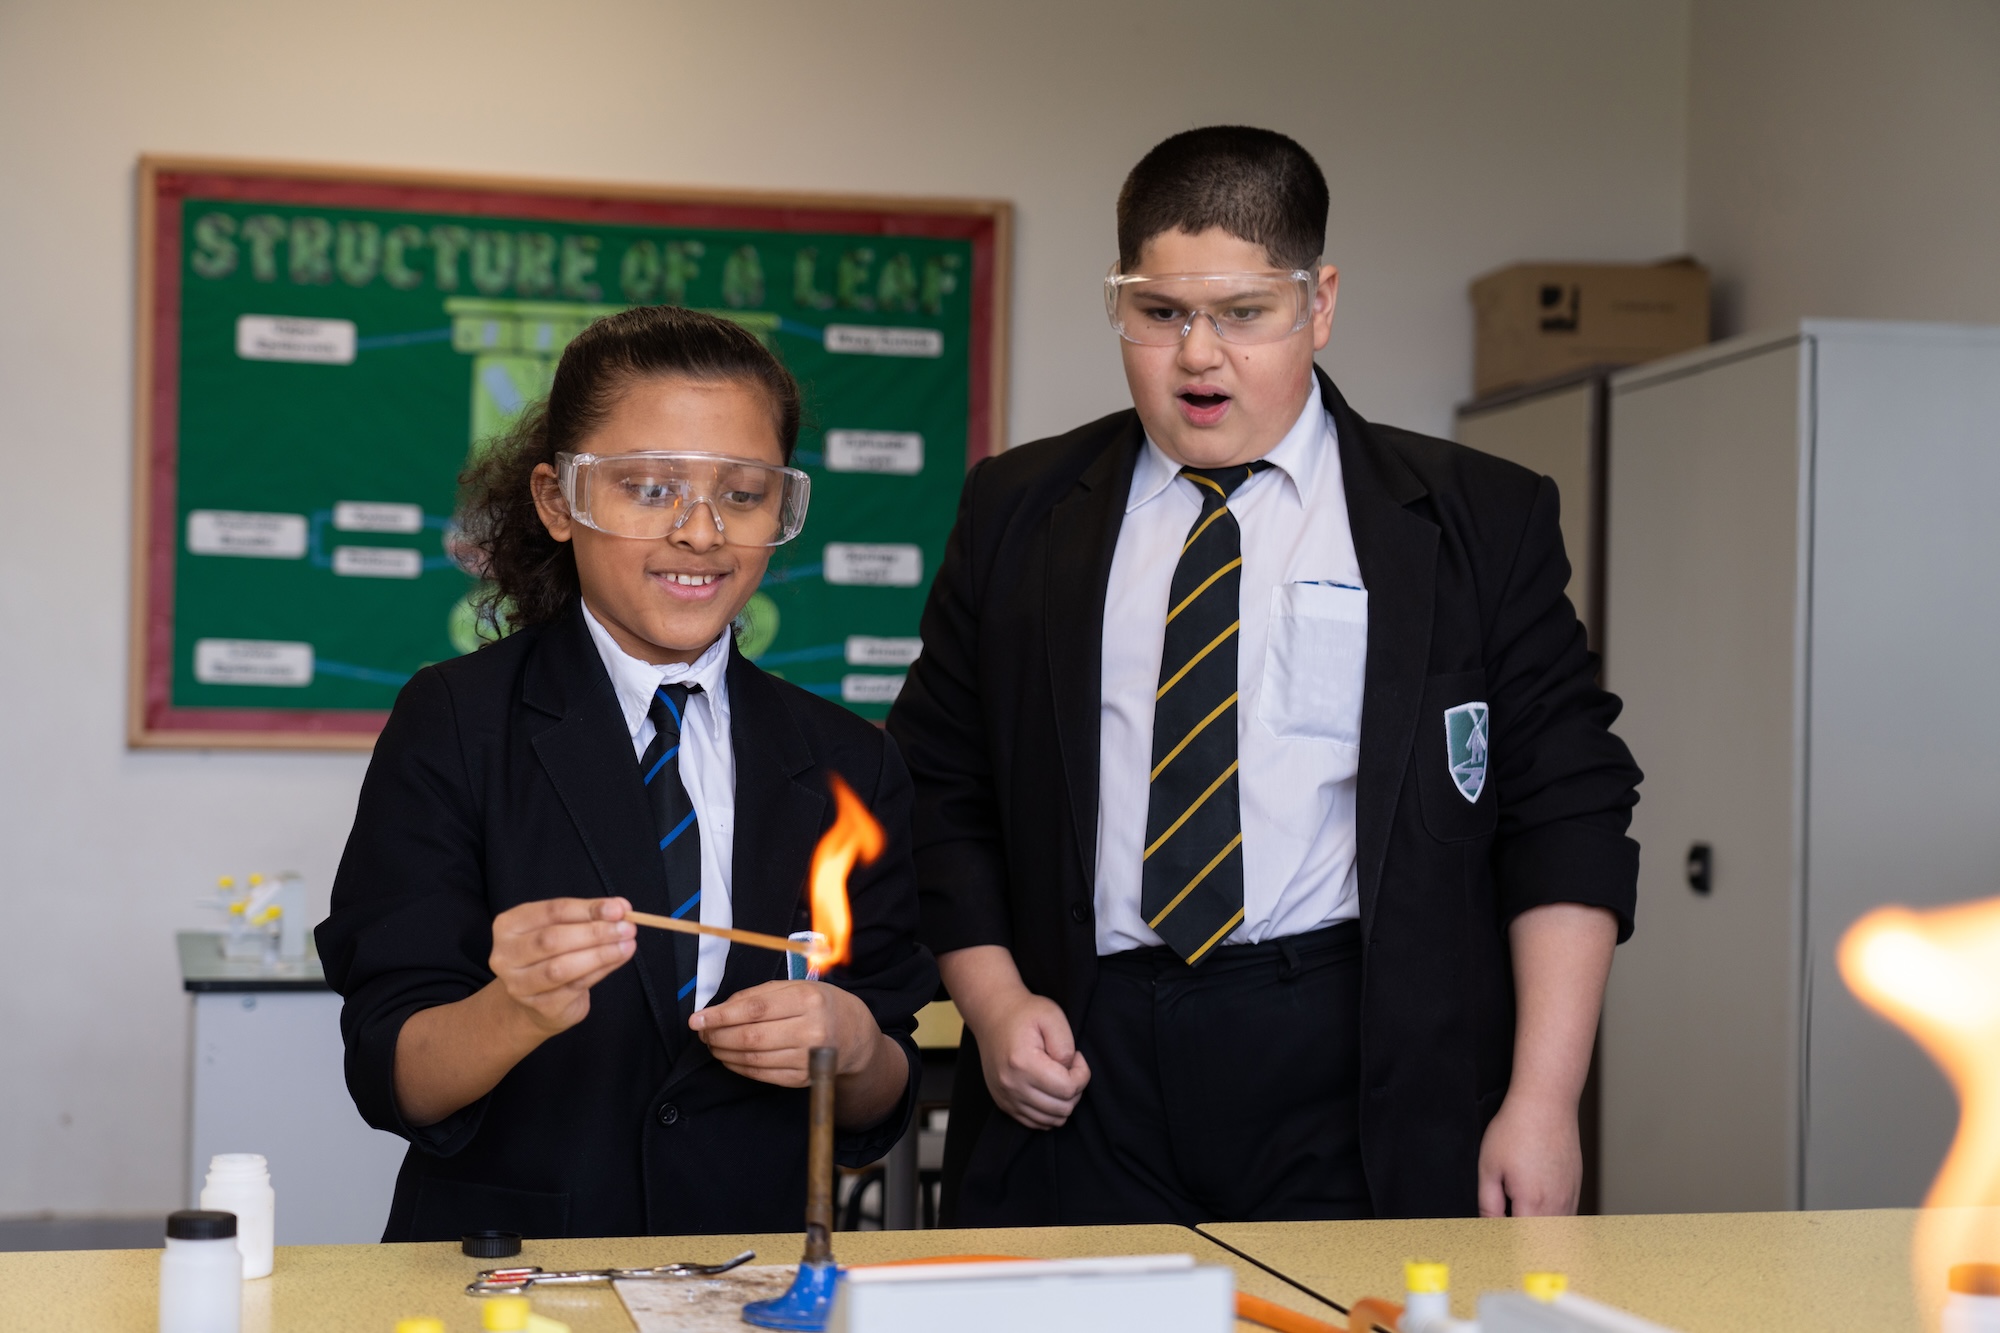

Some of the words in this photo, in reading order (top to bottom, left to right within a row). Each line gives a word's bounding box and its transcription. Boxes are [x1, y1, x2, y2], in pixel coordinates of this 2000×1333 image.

[192, 213, 600, 297] STRUCTURE
[622, 239, 703, 303] OF
[724, 244, 764, 307] A
[795, 248, 960, 313] LEAF
